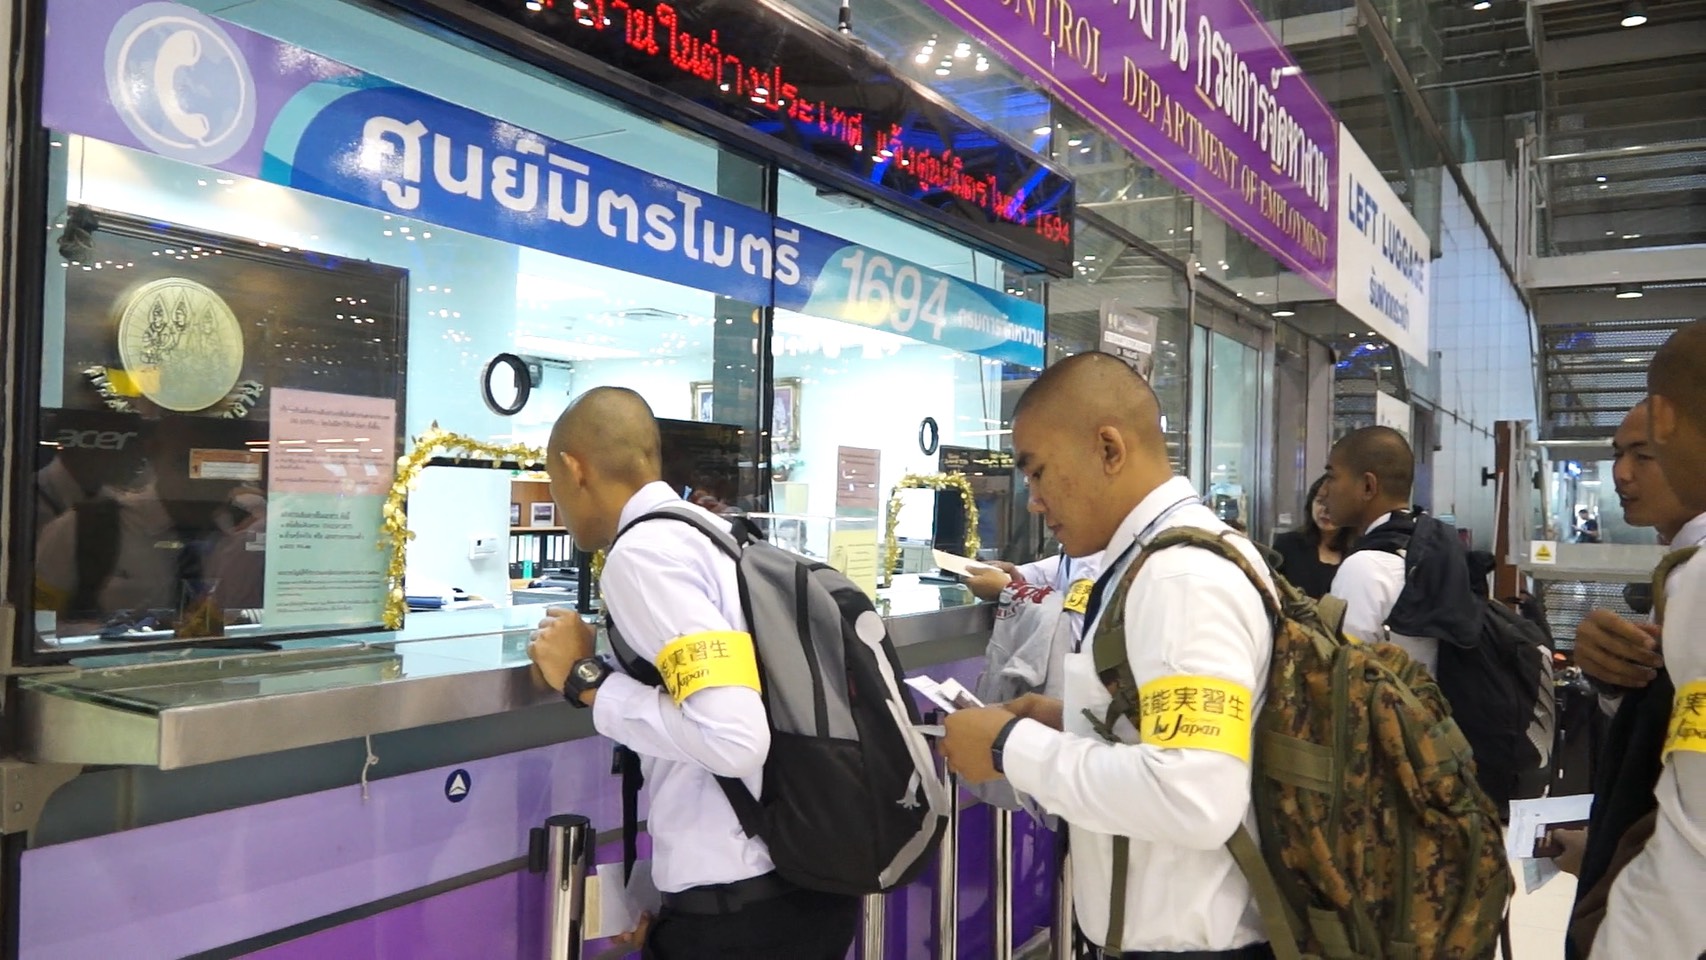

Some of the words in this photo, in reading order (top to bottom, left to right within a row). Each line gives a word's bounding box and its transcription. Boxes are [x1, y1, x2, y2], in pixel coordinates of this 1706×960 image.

[1123, 56, 1238, 190] DEPARTMENT
[1241, 165, 1258, 205] OF
[1261, 180, 1328, 264] EMPLOYMENT
[363, 115, 800, 286] ศูนย์มิตรไมตรี
[841, 249, 949, 341] 1694
[1036, 210, 1070, 246] 1694
[1348, 172, 1378, 244] LEFT
[1382, 212, 1425, 294] LUGGAGE
[56, 428, 138, 450] acer
